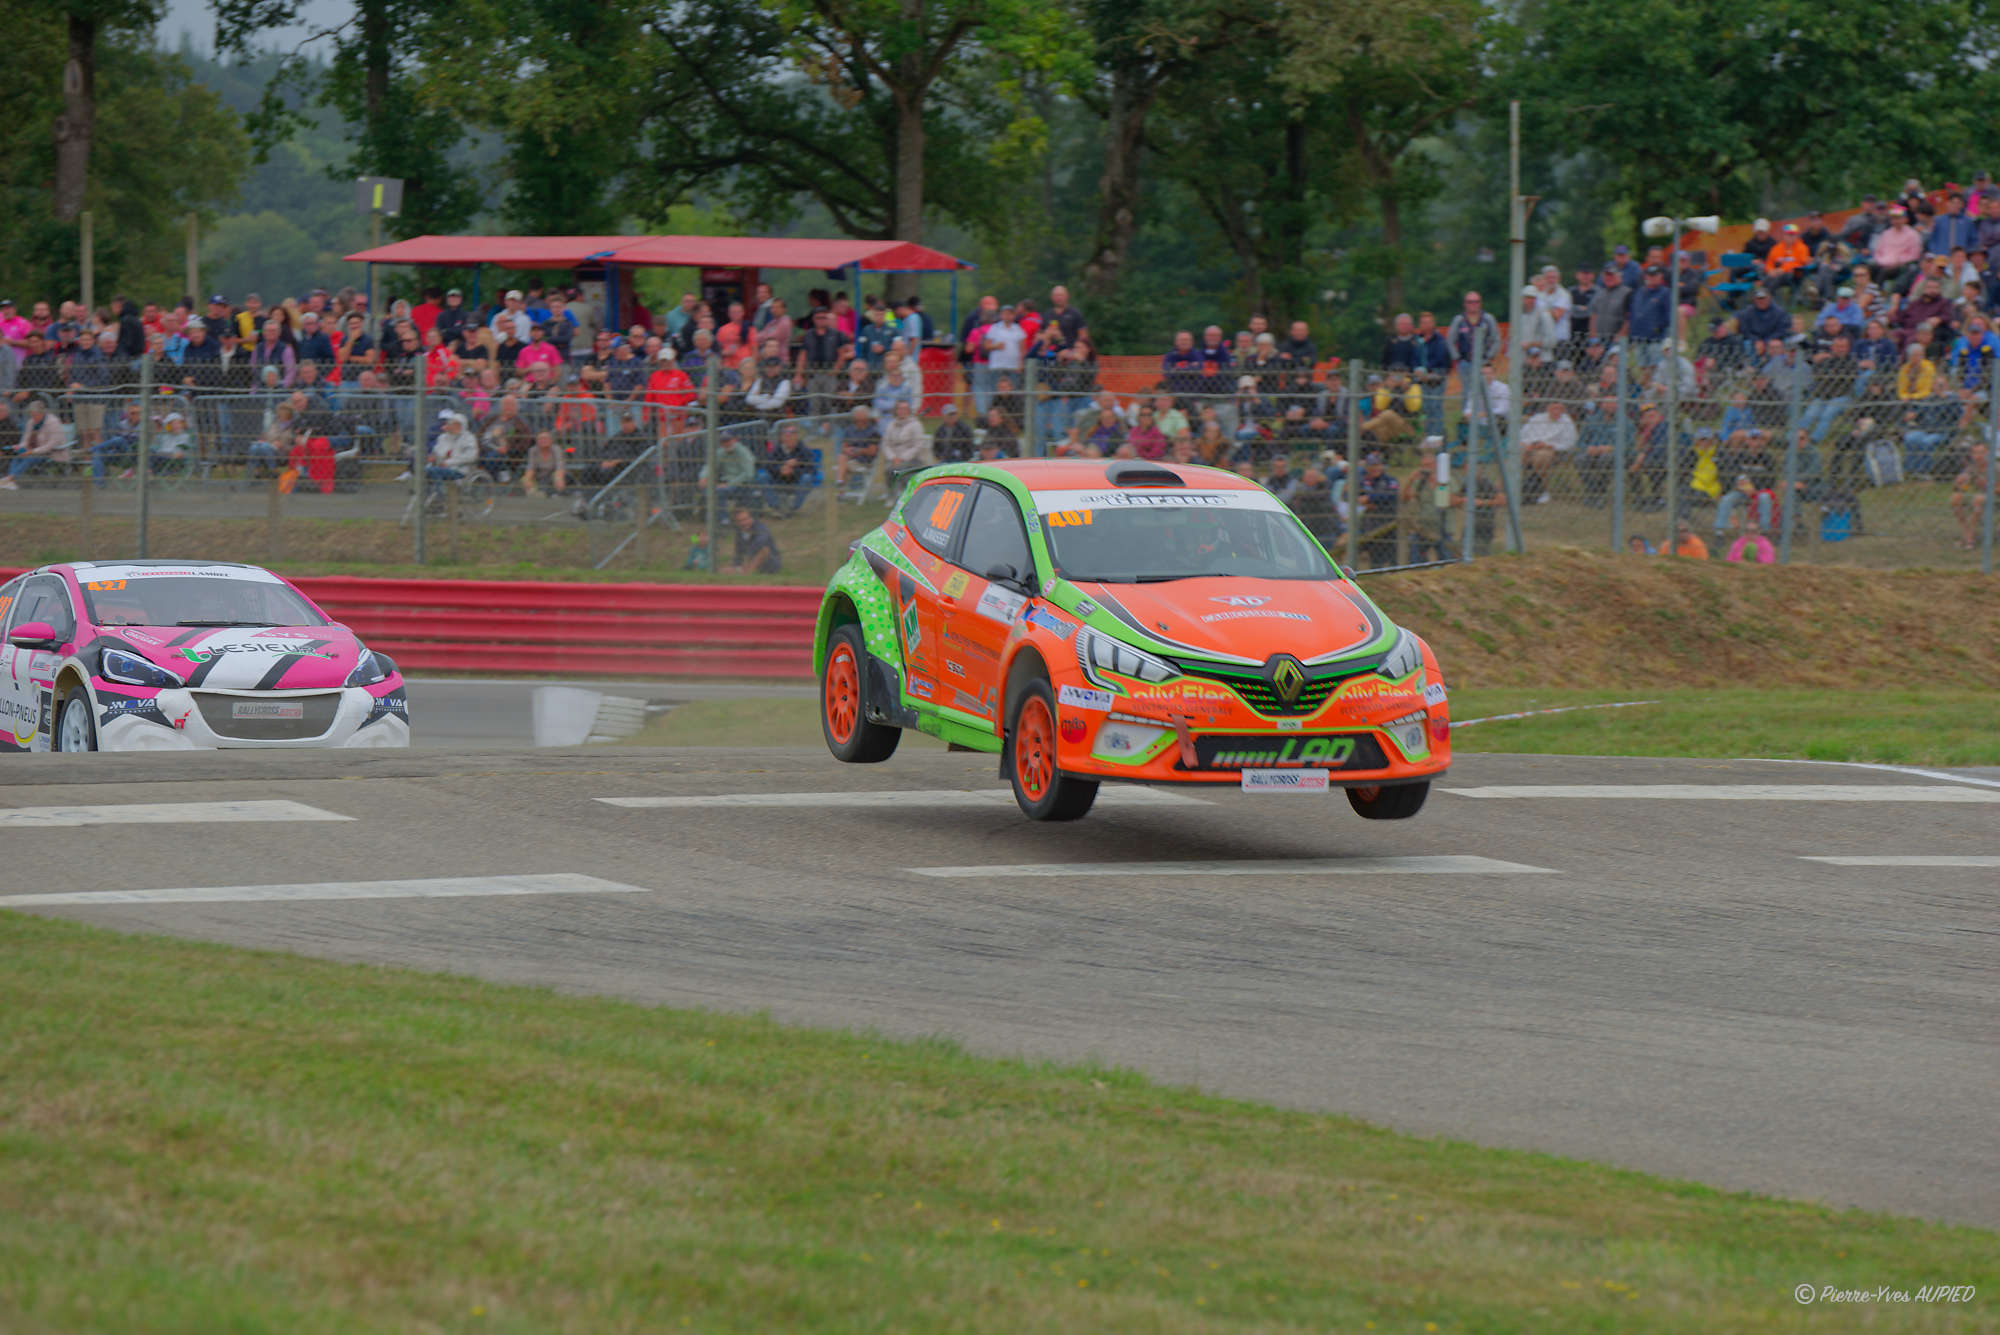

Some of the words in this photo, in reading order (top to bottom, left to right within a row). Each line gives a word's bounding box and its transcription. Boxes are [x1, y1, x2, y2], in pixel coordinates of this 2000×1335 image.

[930, 488, 965, 531] 407
[1048, 509, 1092, 527] 407
[88, 579, 126, 591] 427
